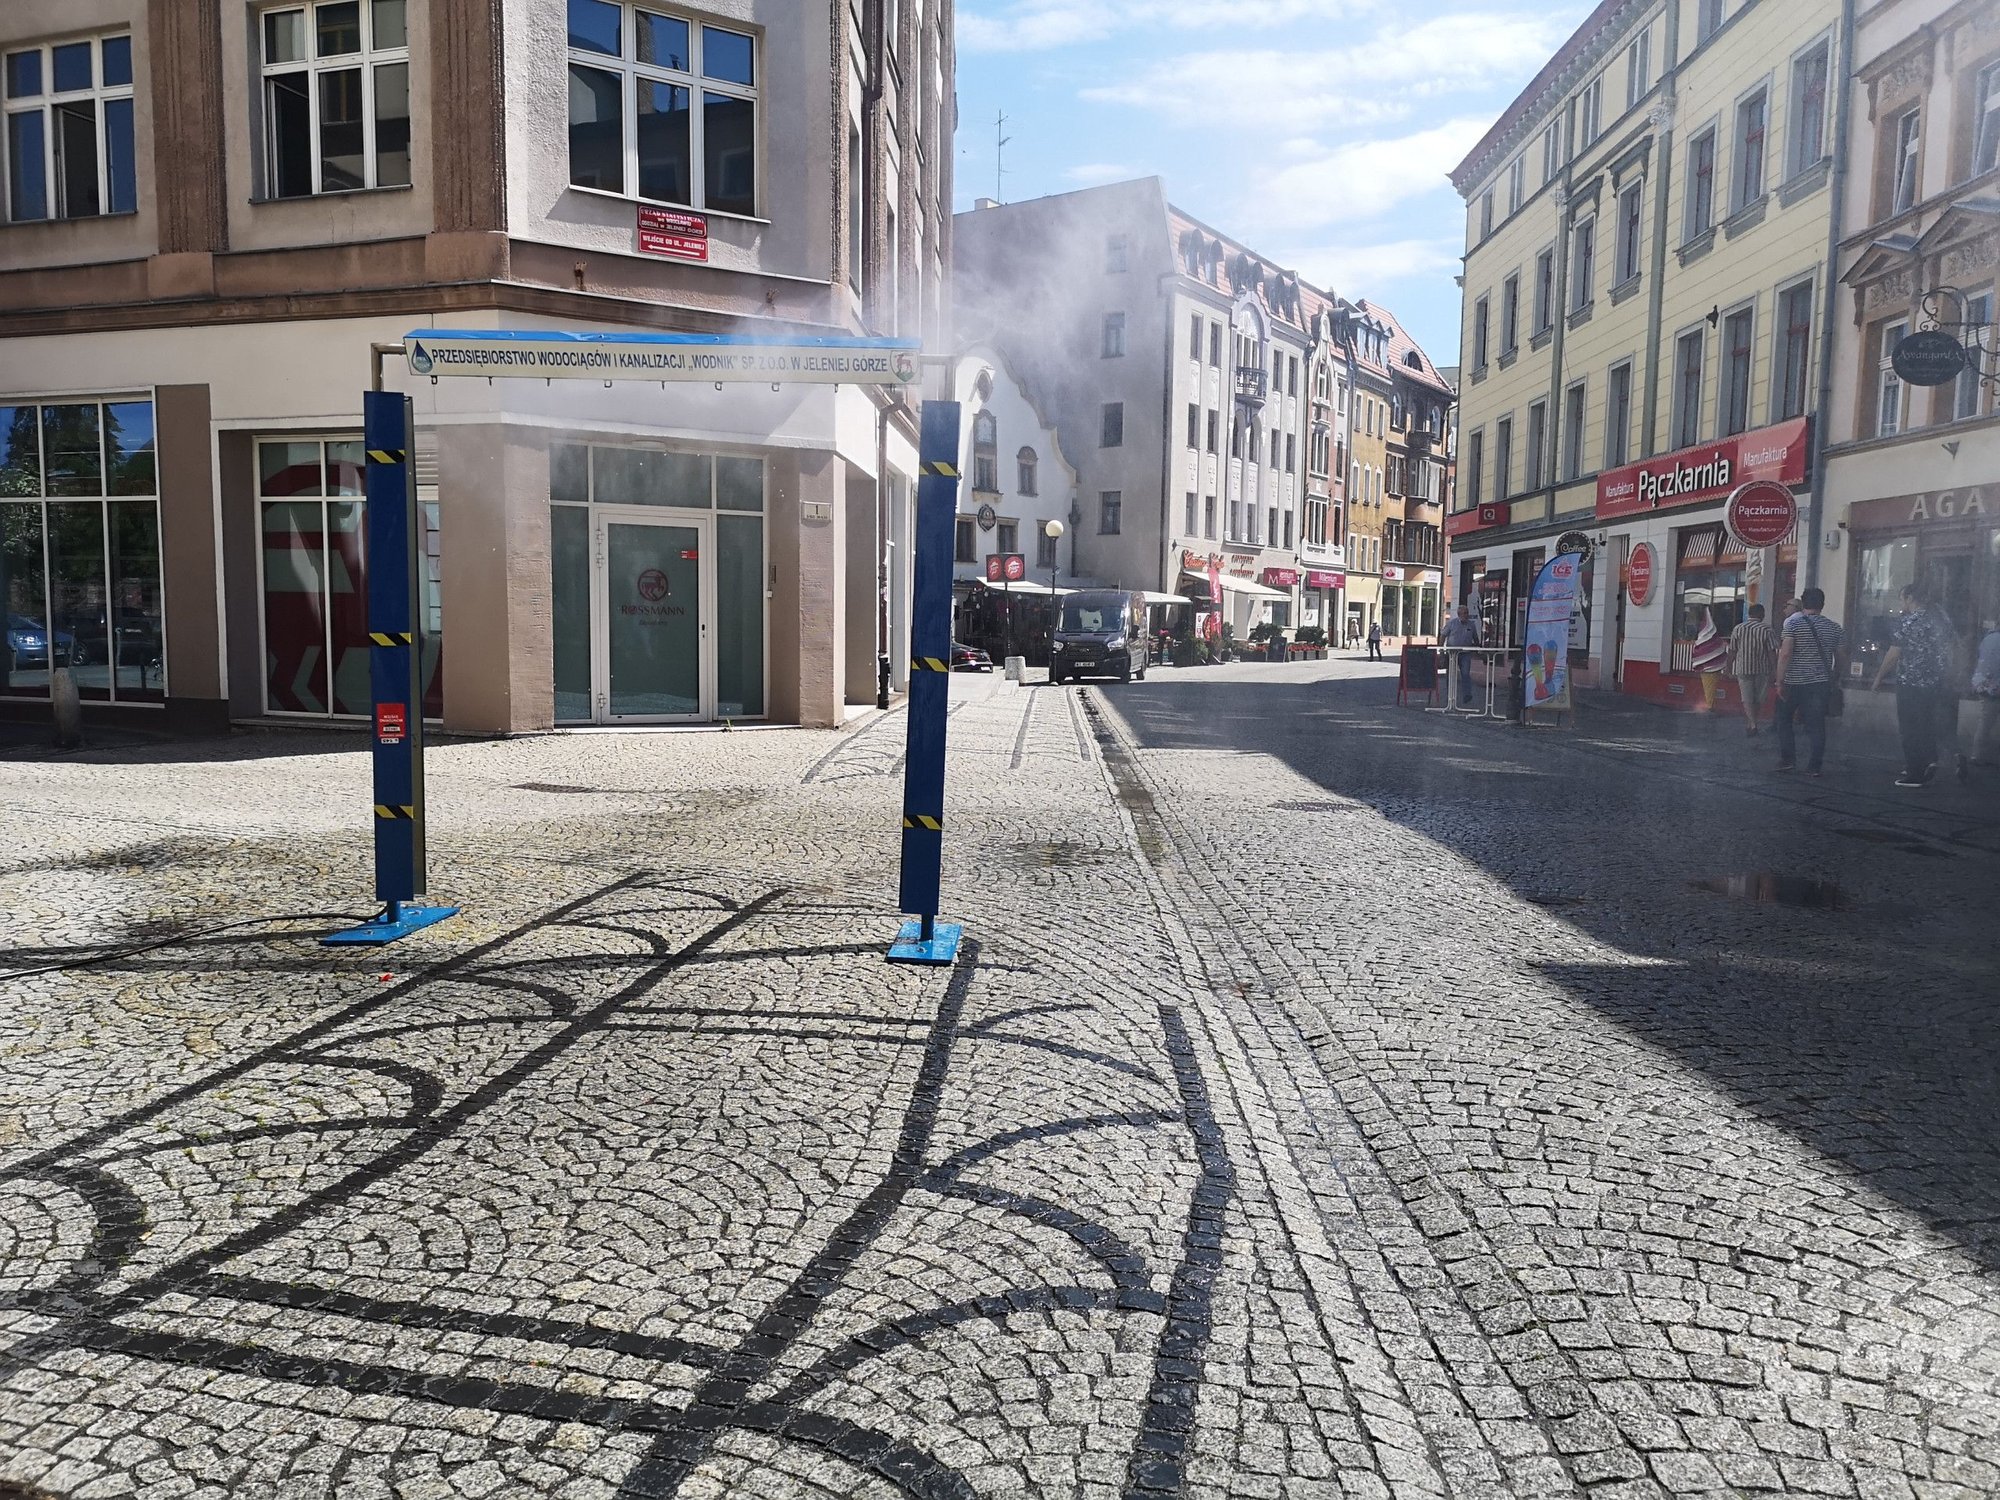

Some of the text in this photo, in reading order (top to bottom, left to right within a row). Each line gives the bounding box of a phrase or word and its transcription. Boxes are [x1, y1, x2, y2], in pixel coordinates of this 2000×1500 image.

[642, 234, 664, 244] WEJŚCIE
[431, 348, 536, 367] PRZEDSIĘBIORSTWO
[538, 349, 611, 370] WODOCIĄGÓW
[614, 353, 618, 367] I
[620, 353, 685, 369] KANALIZACJI
[742, 356, 757, 369] SP.
[791, 356, 800, 370] W
[803, 357, 849, 372] JELENIEJ
[853, 354, 887, 372] GÓRZE
[1605, 447, 1787, 507] Manufaktura Pączkarnia Manufaktura
[1738, 505, 1788, 518] Pączkarnia
[1552, 566, 1572, 575] ICE
[621, 604, 685, 617] ROSSMANN
